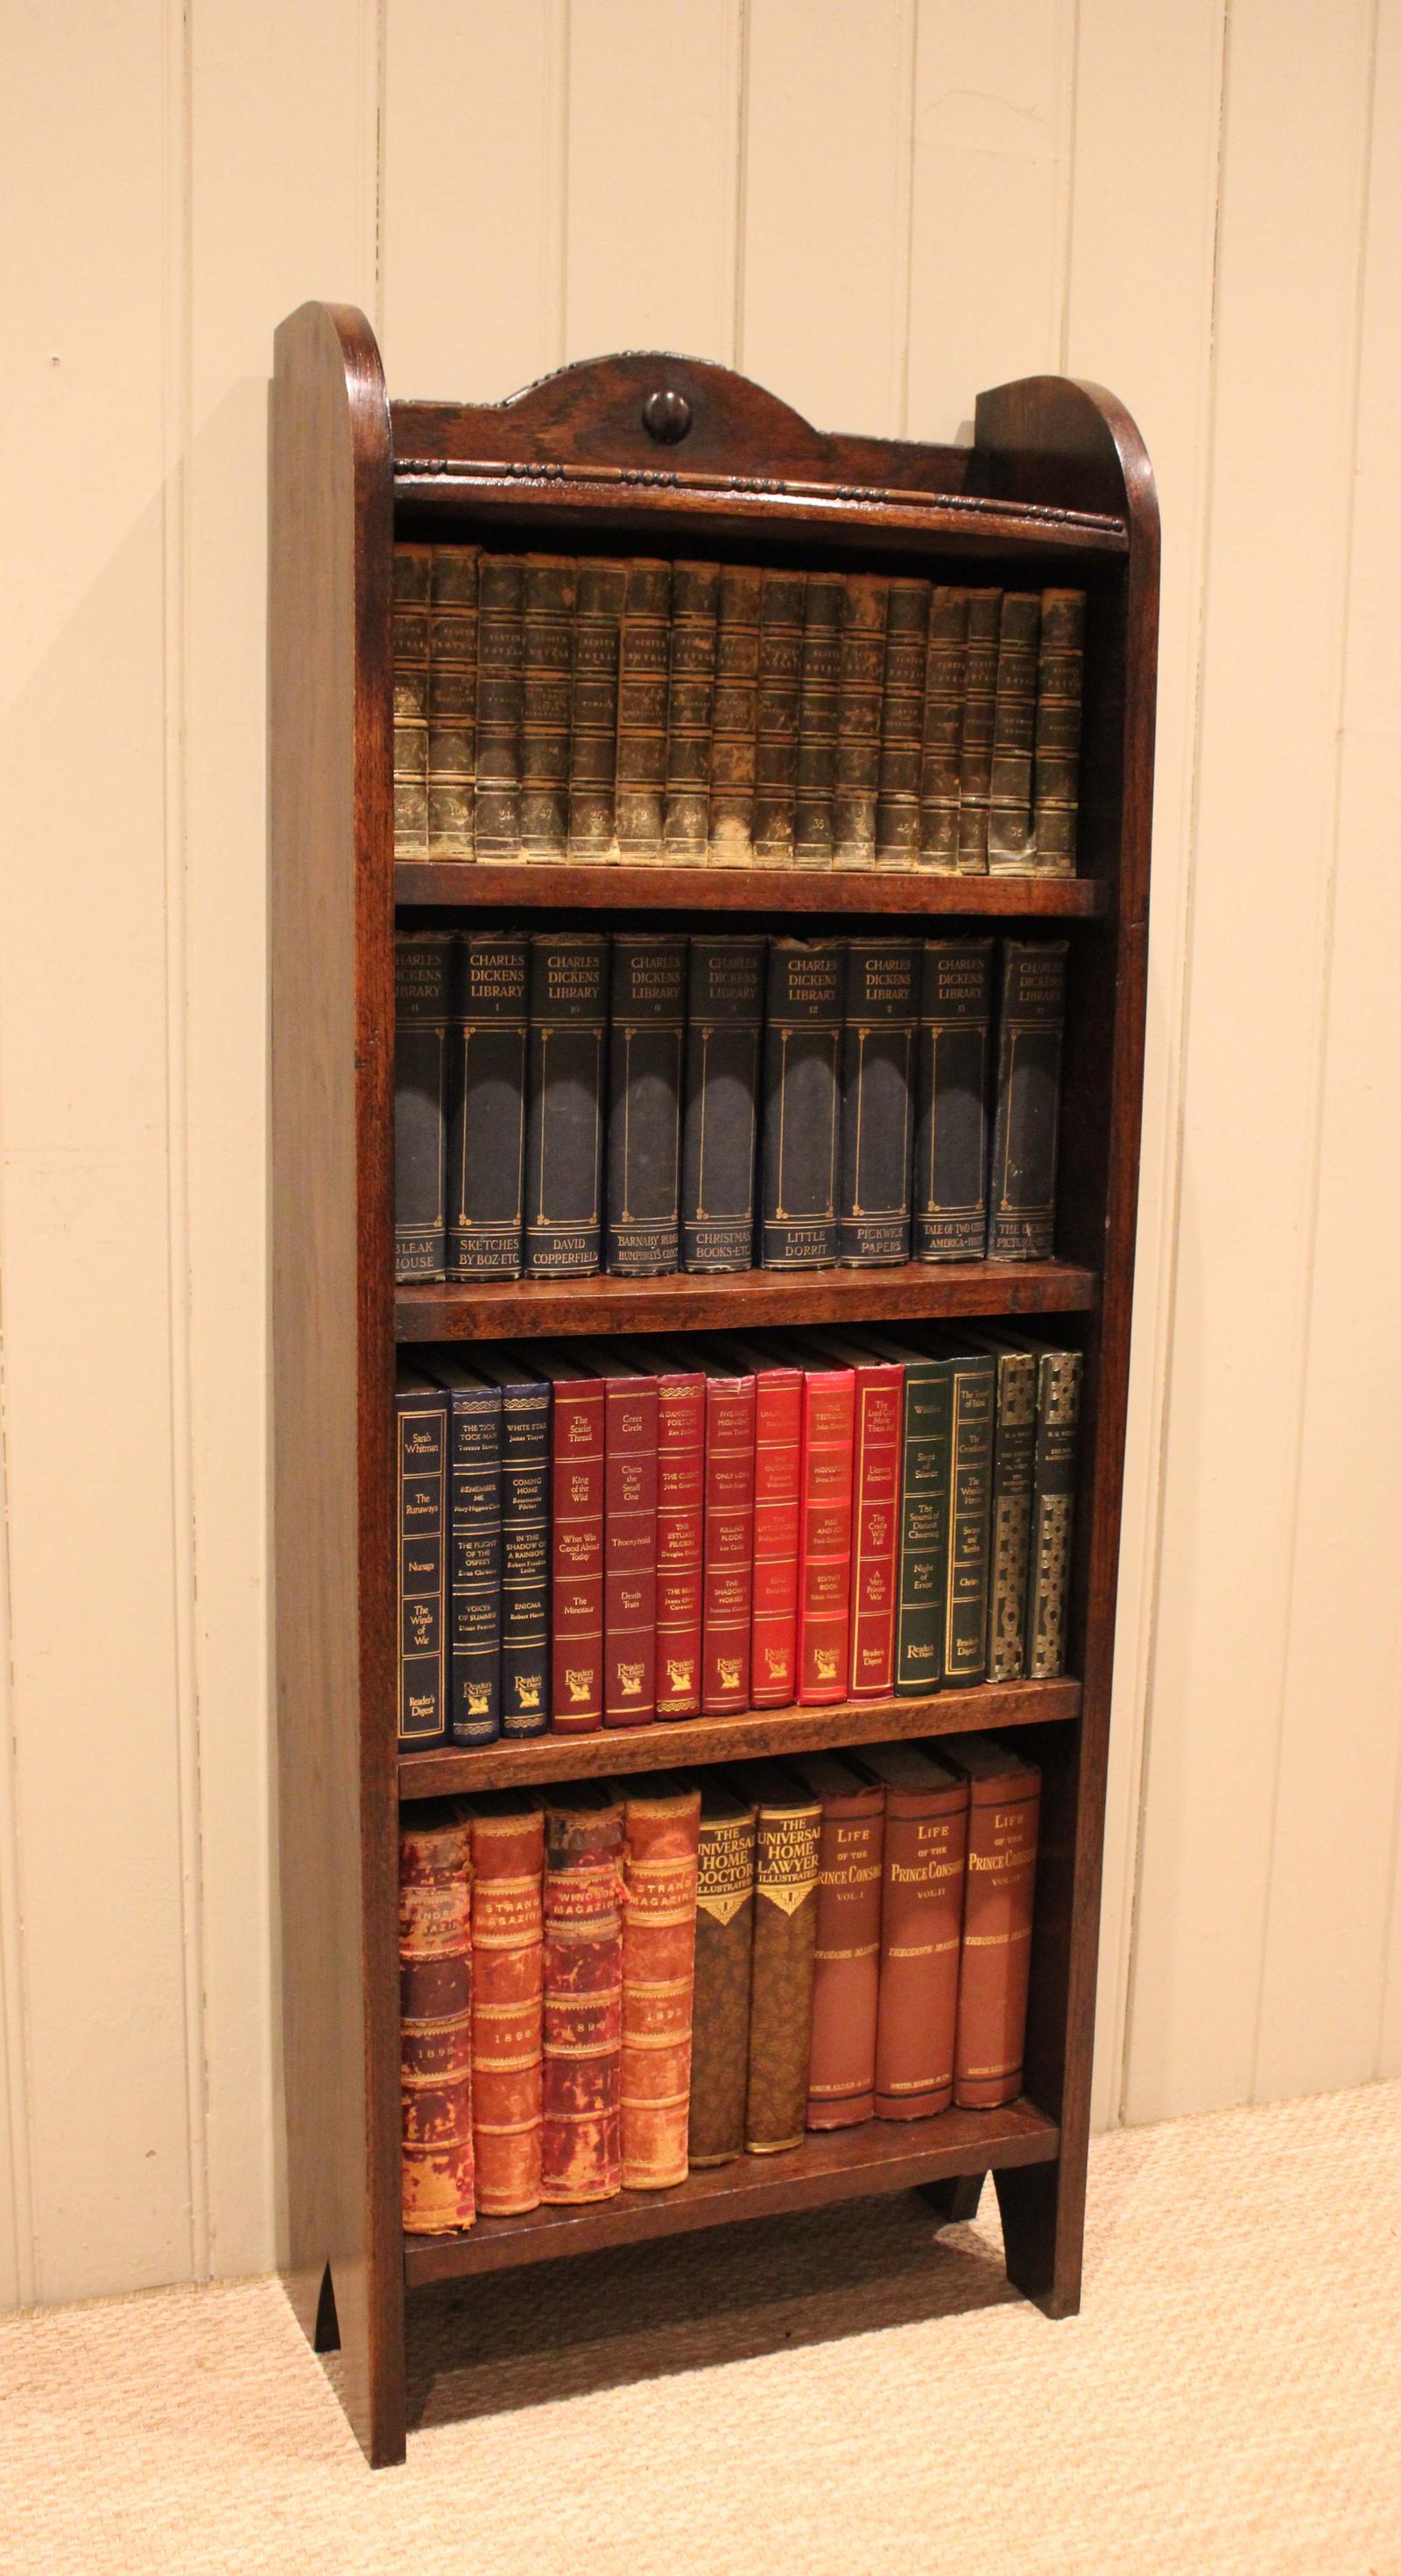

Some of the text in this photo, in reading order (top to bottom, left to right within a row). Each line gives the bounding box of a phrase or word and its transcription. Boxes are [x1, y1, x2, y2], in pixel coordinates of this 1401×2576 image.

[396, 954, 441, 966] HARLES
[469, 954, 524, 966] CHARLES
[546, 956, 601, 969] CHARLES
[630, 957, 680, 969] CHARLES
[708, 958, 757, 970] CHARLES
[788, 960, 837, 971] CHARLES
[865, 960, 911, 971] CHARLES
[939, 959, 984, 970] CHARLES
[396, 970, 441, 982] ICKENS
[470, 970, 525, 982] DICKENS
[547, 971, 601, 984] DICKENS
[631, 972, 680, 984] DICKENS
[708, 973, 757, 985] DICKENS
[788, 974, 837, 986] DICKENS
[865, 974, 912, 985] DICKENS
[939, 973, 984, 985] DICKENS
[396, 985, 441, 998] IBRARY
[470, 985, 524, 998] LIBRARY
[548, 987, 600, 999] LIBRARY
[631, 987, 680, 999] LIBRARY
[709, 988, 757, 999] LIBRARY
[789, 989, 836, 1001] LIBRARY
[865, 988, 911, 1000] LIBRARY
[939, 987, 982, 999] LIBRARY
[1019, 990, 1060, 1002] LIBRARY
[495, 1003, 500, 1012] 1
[808, 1006, 819, 1014] 12
[886, 1005, 893, 1013] 2
[857, 1227, 904, 1240] PICKWICK
[925, 1224, 943, 1235] TALE
[944, 1224, 954, 1234] OF
[618, 1236, 658, 1247] BARNABY
[695, 1232, 751, 1244] CHRISTMAS
[787, 1231, 826, 1243] LITTLE
[460, 1239, 518, 1251] SKETCHES
[553, 1239, 586, 1250] DAVID
[785, 1244, 827, 1256] DORRIT
[861, 1240, 901, 1253] PAPERS
[459, 1254, 475, 1266] BY
[532, 1251, 598, 1264] COPPERFIELD
[574, 1415, 588, 1425] The
[412, 1432, 433, 1444] Sarah
[512, 1477, 542, 1486] COMING
[572, 1476, 589, 1486] King
[415, 1493, 430, 1504] The
[573, 1596, 588, 1606] The
[413, 1605, 429, 1615] The
[410, 1615, 433, 1626] Winds
[781, 1817, 806, 1831] THE
[994, 1814, 1024, 1829] LIFE
[715, 1827, 740, 1842] THE
[837, 1828, 870, 1843] LIFE
[918, 1824, 950, 1840] LIFE
[698, 1835, 755, 1856] NIVERSAL
[994, 1838, 1004, 1847] OF
[767, 1841, 814, 1860] HOME
[837, 1850, 869, 1861] OF THE
[918, 1846, 947, 1858] OF THE
[702, 1850, 749, 1871] HOME
[757, 1854, 820, 1874] LAWYER
[968, 1852, 1005, 1872] PRINCE
[697, 1863, 753, 1885] DOCTOR
[758, 1868, 818, 1883] ILLUSTRATED
[819, 1870, 848, 1886] RINCE
[891, 1862, 928, 1882] PRINCE
[637, 1879, 691, 1894] STRAND
[698, 1877, 752, 1894] LLUSTRATED
